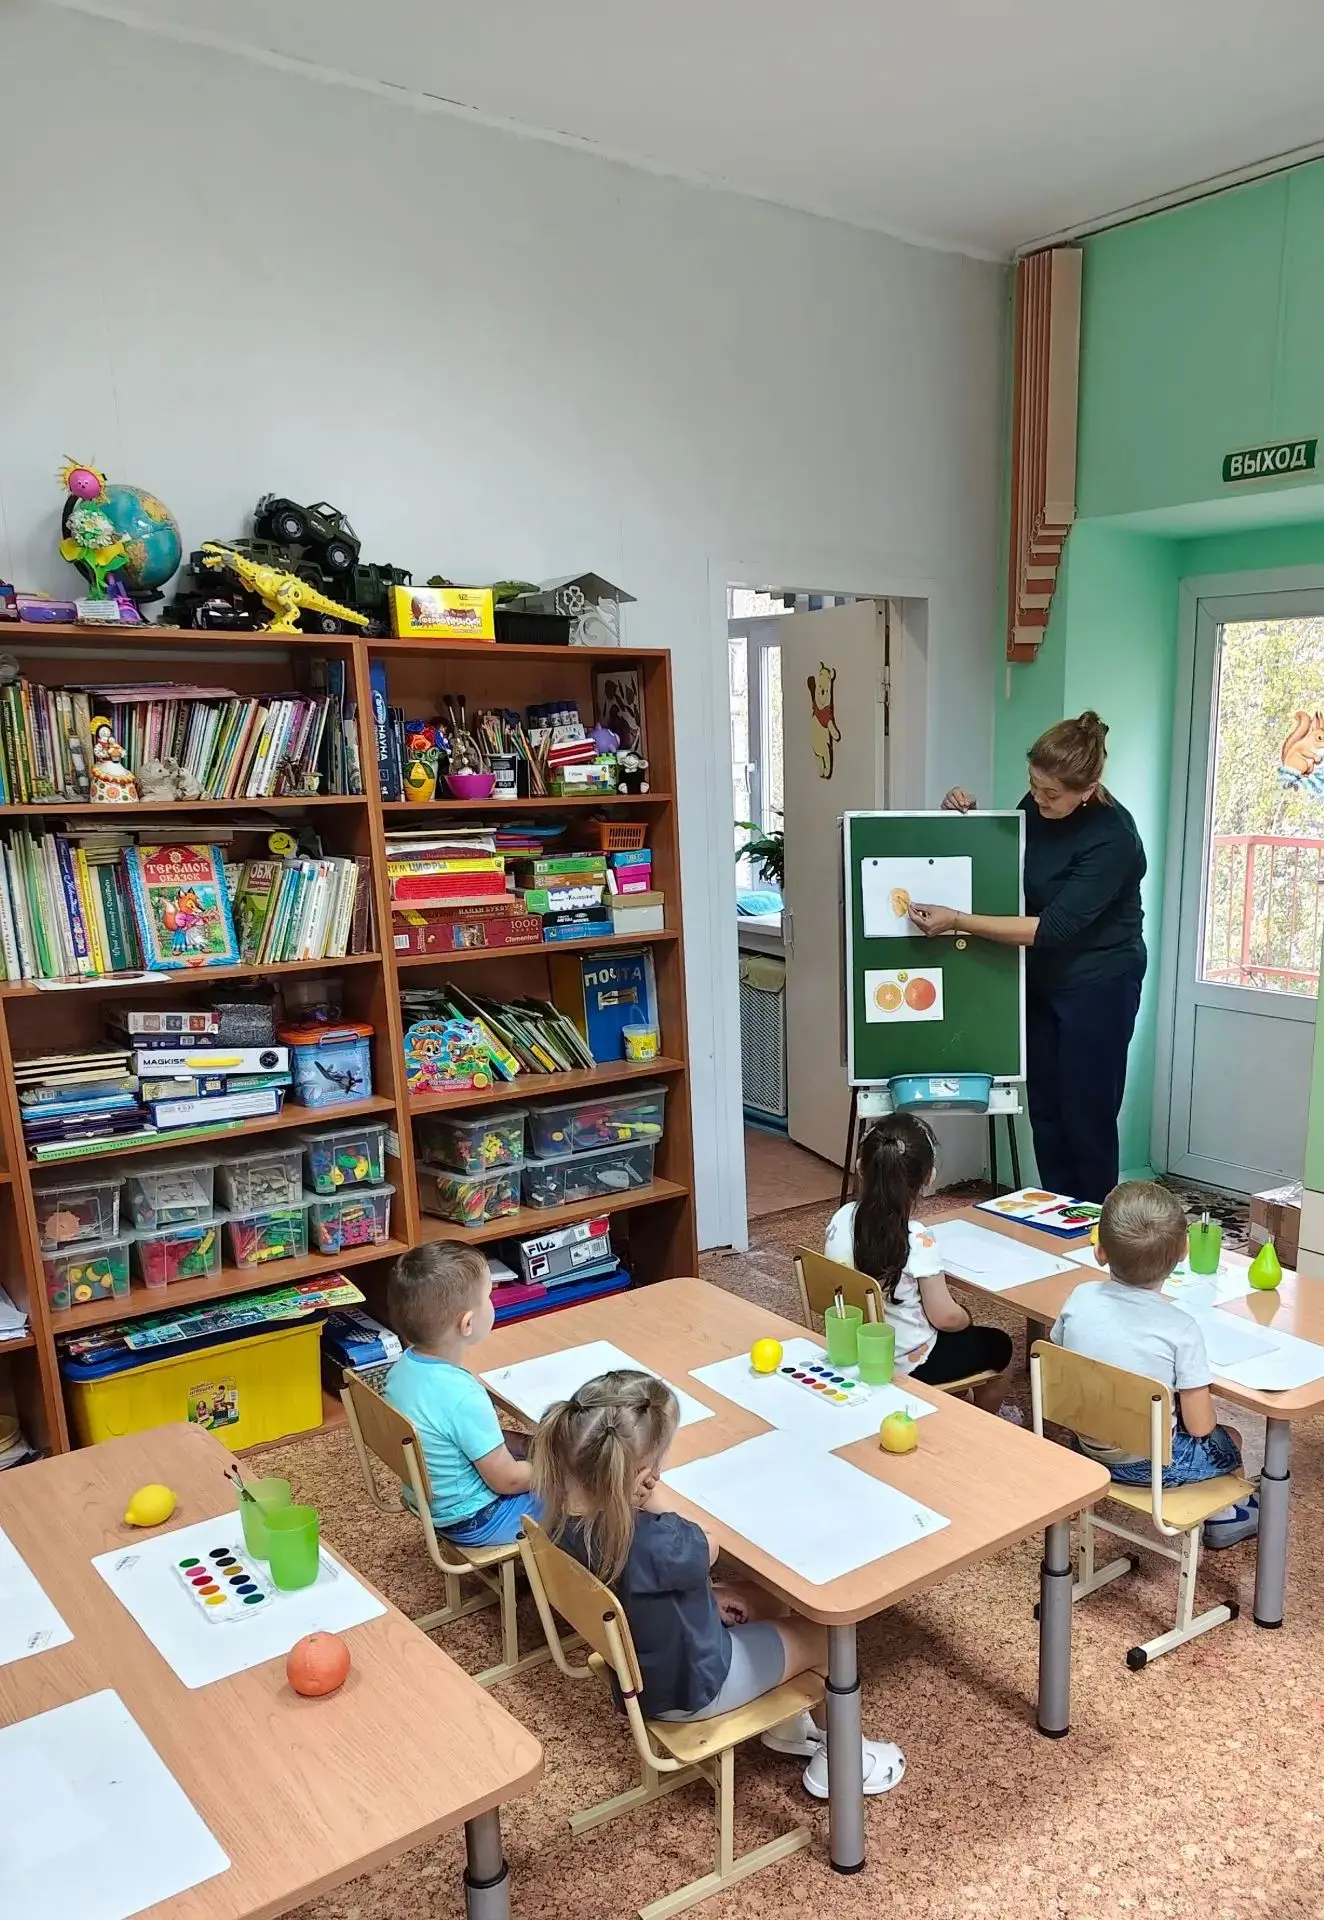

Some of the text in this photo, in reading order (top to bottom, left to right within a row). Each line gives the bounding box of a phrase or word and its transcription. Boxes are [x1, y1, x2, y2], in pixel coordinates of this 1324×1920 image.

[1230, 444, 1307, 477] ВЫХОД
[146, 862, 209, 874] ТЕРЕМОК
[251, 863, 274, 880] ОБЖ
[408, 861, 448, 872] ЦИФРЫ
[159, 873, 201, 882] СКАЗОК
[511, 919, 538, 928] 1000
[505, 934, 539, 943] Clementoni
[584, 967, 642, 986] ПОЧТА
[527, 1242, 555, 1255] FILA
